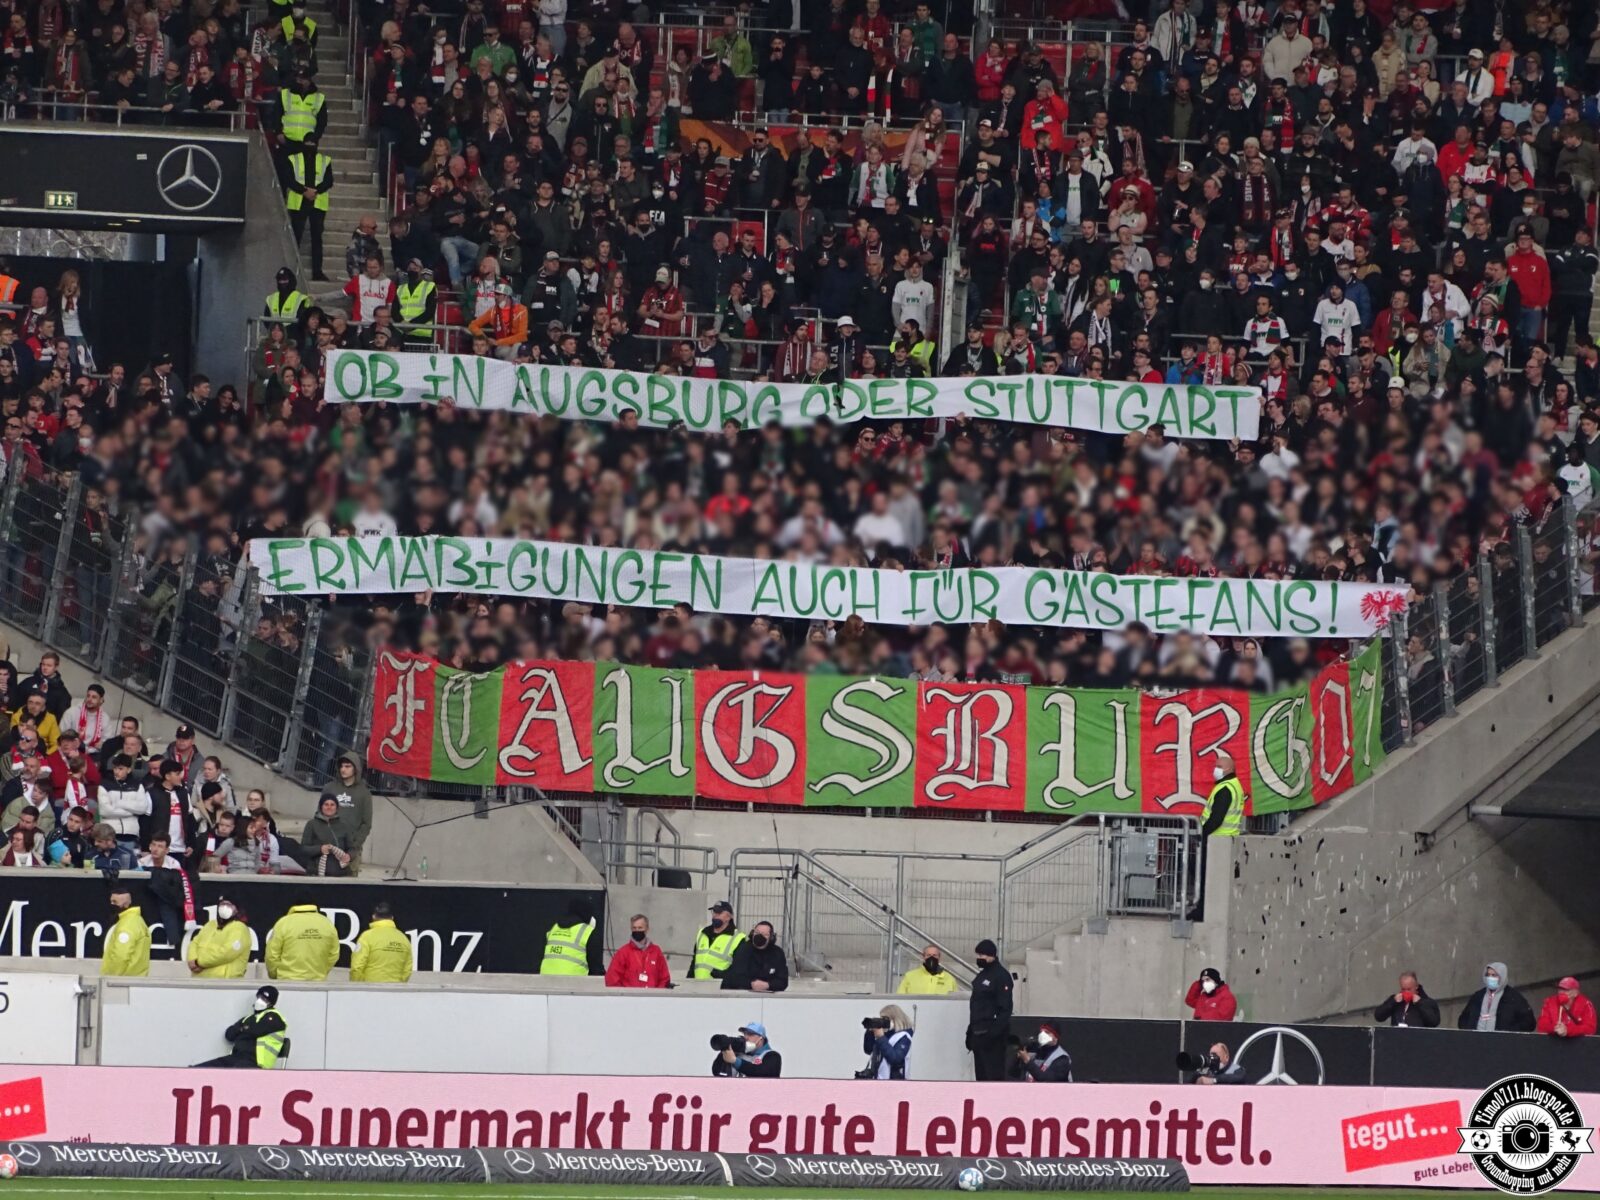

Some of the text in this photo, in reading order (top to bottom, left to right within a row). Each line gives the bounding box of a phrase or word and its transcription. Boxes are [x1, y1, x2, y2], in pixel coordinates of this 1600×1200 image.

[333, 351, 404, 401] OB
[511, 364, 782, 431] AUGSBURG
[800, 377, 940, 420] ODER
[964, 377, 1257, 438] STUTTGART
[751, 562, 881, 622] AUCH
[901, 567, 1000, 623] FÜR
[1024, 569, 1339, 635] GÄSTEFANS!
[498, 663, 1312, 811] AUGSBURG
[172, 1085, 1273, 1167] Ihr Supermarkt für gute Lebensmittel.
[1347, 1111, 1449, 1151] tegut...
[49, 1144, 222, 1166] Mercedes-Benz
[299, 1148, 466, 1169] Mercedes-Benz
[547, 1152, 706, 1173] Mercedes-Benz
[787, 1156, 943, 1177] Mercedes-Benz
[1015, 1160, 1170, 1178] Mercedes-Benz
[1413, 1167, 1440, 1182] gute
